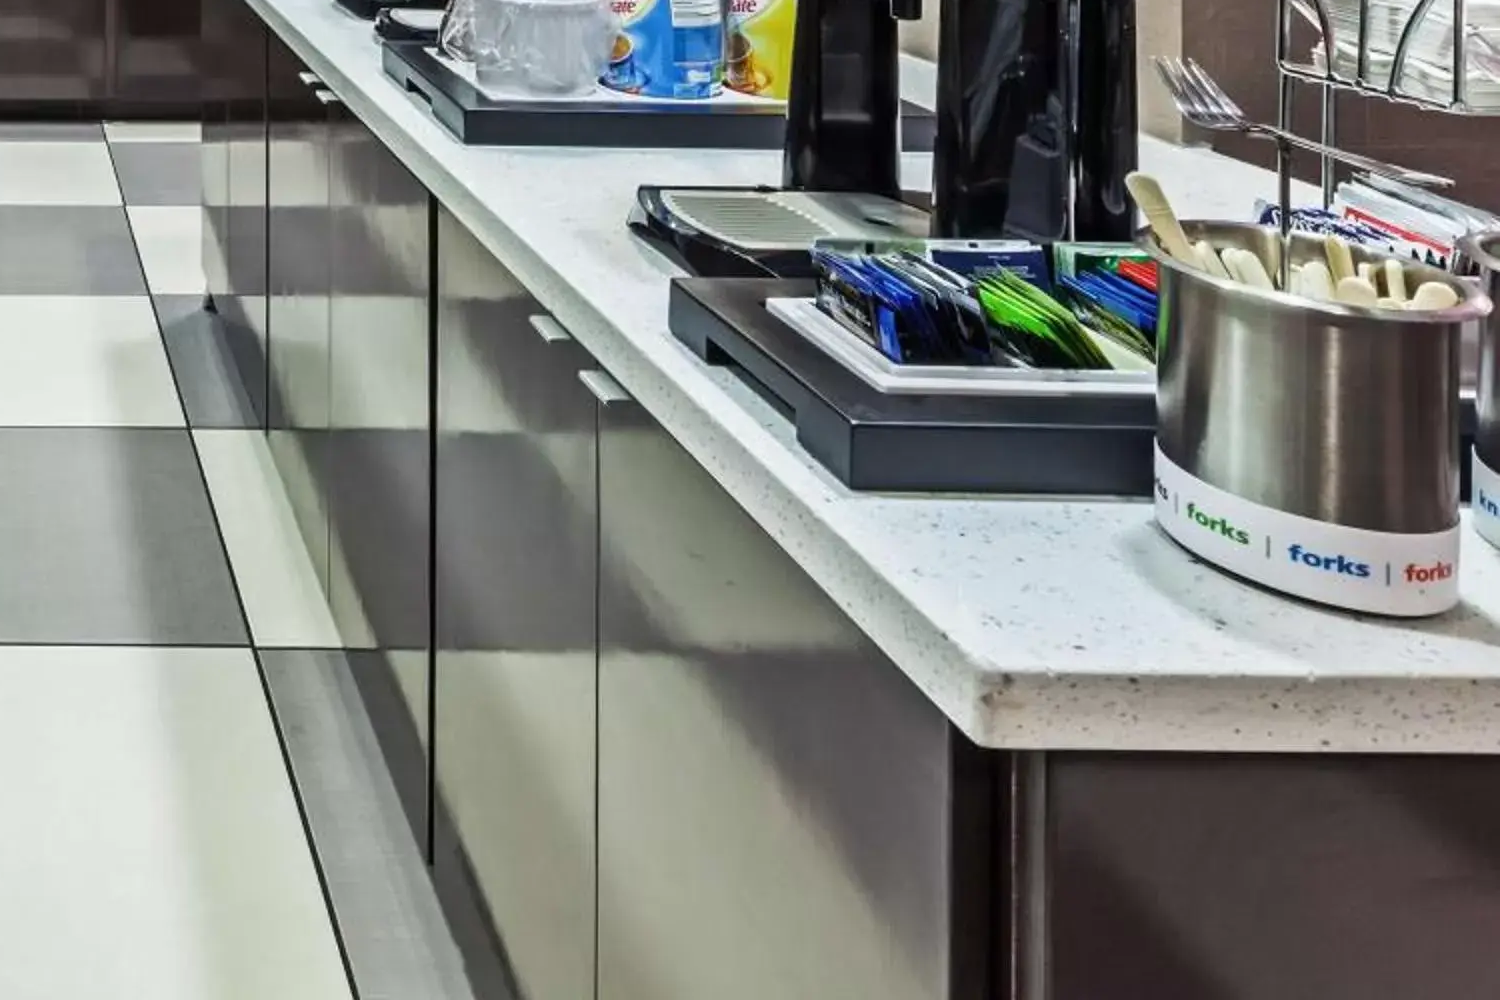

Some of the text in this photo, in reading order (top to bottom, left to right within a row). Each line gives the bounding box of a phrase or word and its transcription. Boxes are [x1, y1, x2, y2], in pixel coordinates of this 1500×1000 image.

[610, 1, 637, 13] ate
[1479, 488, 1500, 517] kn
[1187, 502, 1250, 545] forks
[1287, 543, 1371, 578] forks
